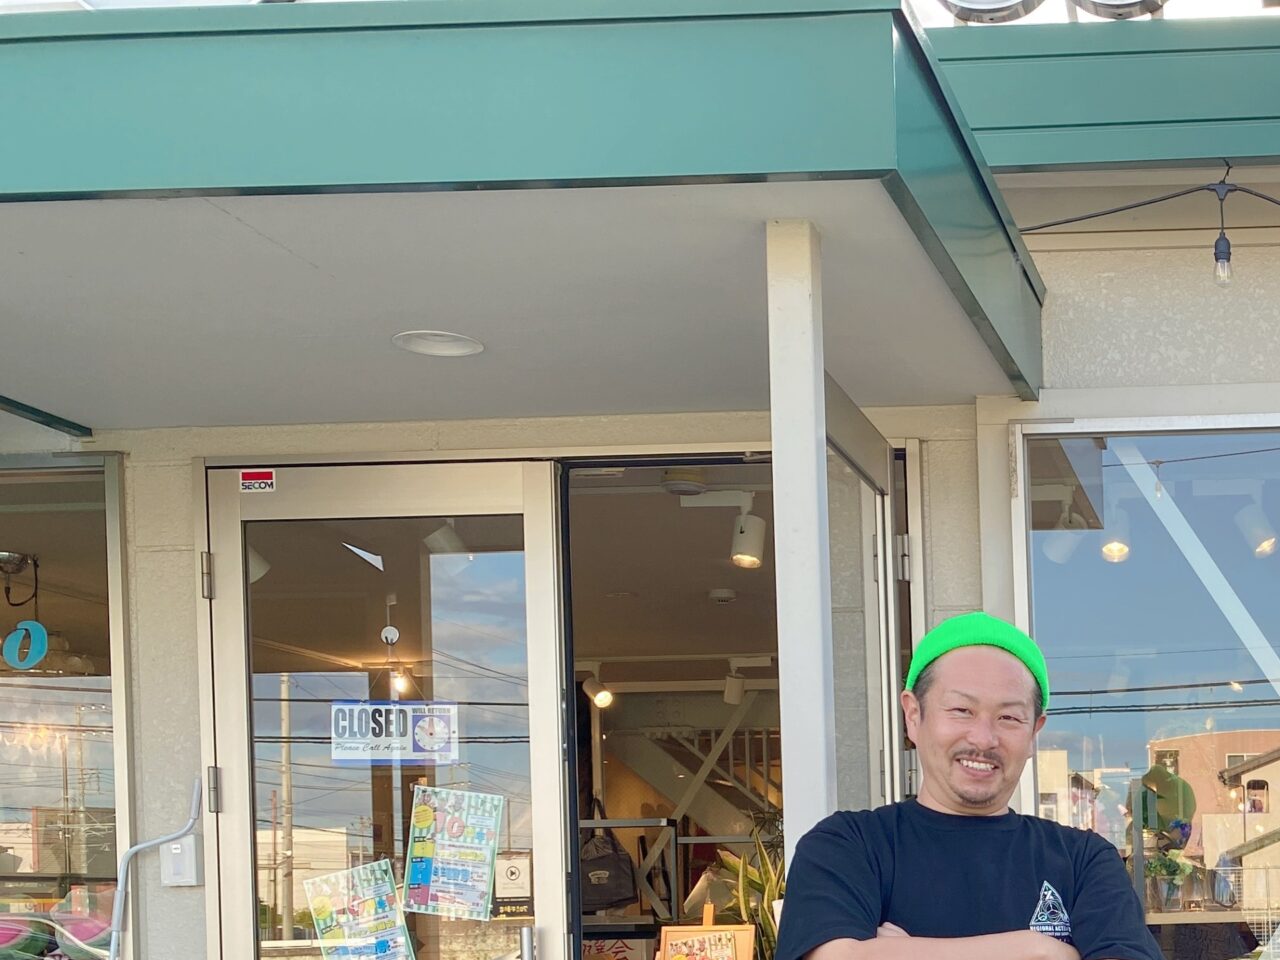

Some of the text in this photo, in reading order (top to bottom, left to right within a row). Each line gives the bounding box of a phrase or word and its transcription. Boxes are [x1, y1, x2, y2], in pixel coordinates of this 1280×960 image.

[241, 481, 274, 490] SECOM
[333, 708, 408, 738] CLOSED
[334, 742, 407, 752] Please Call Again
